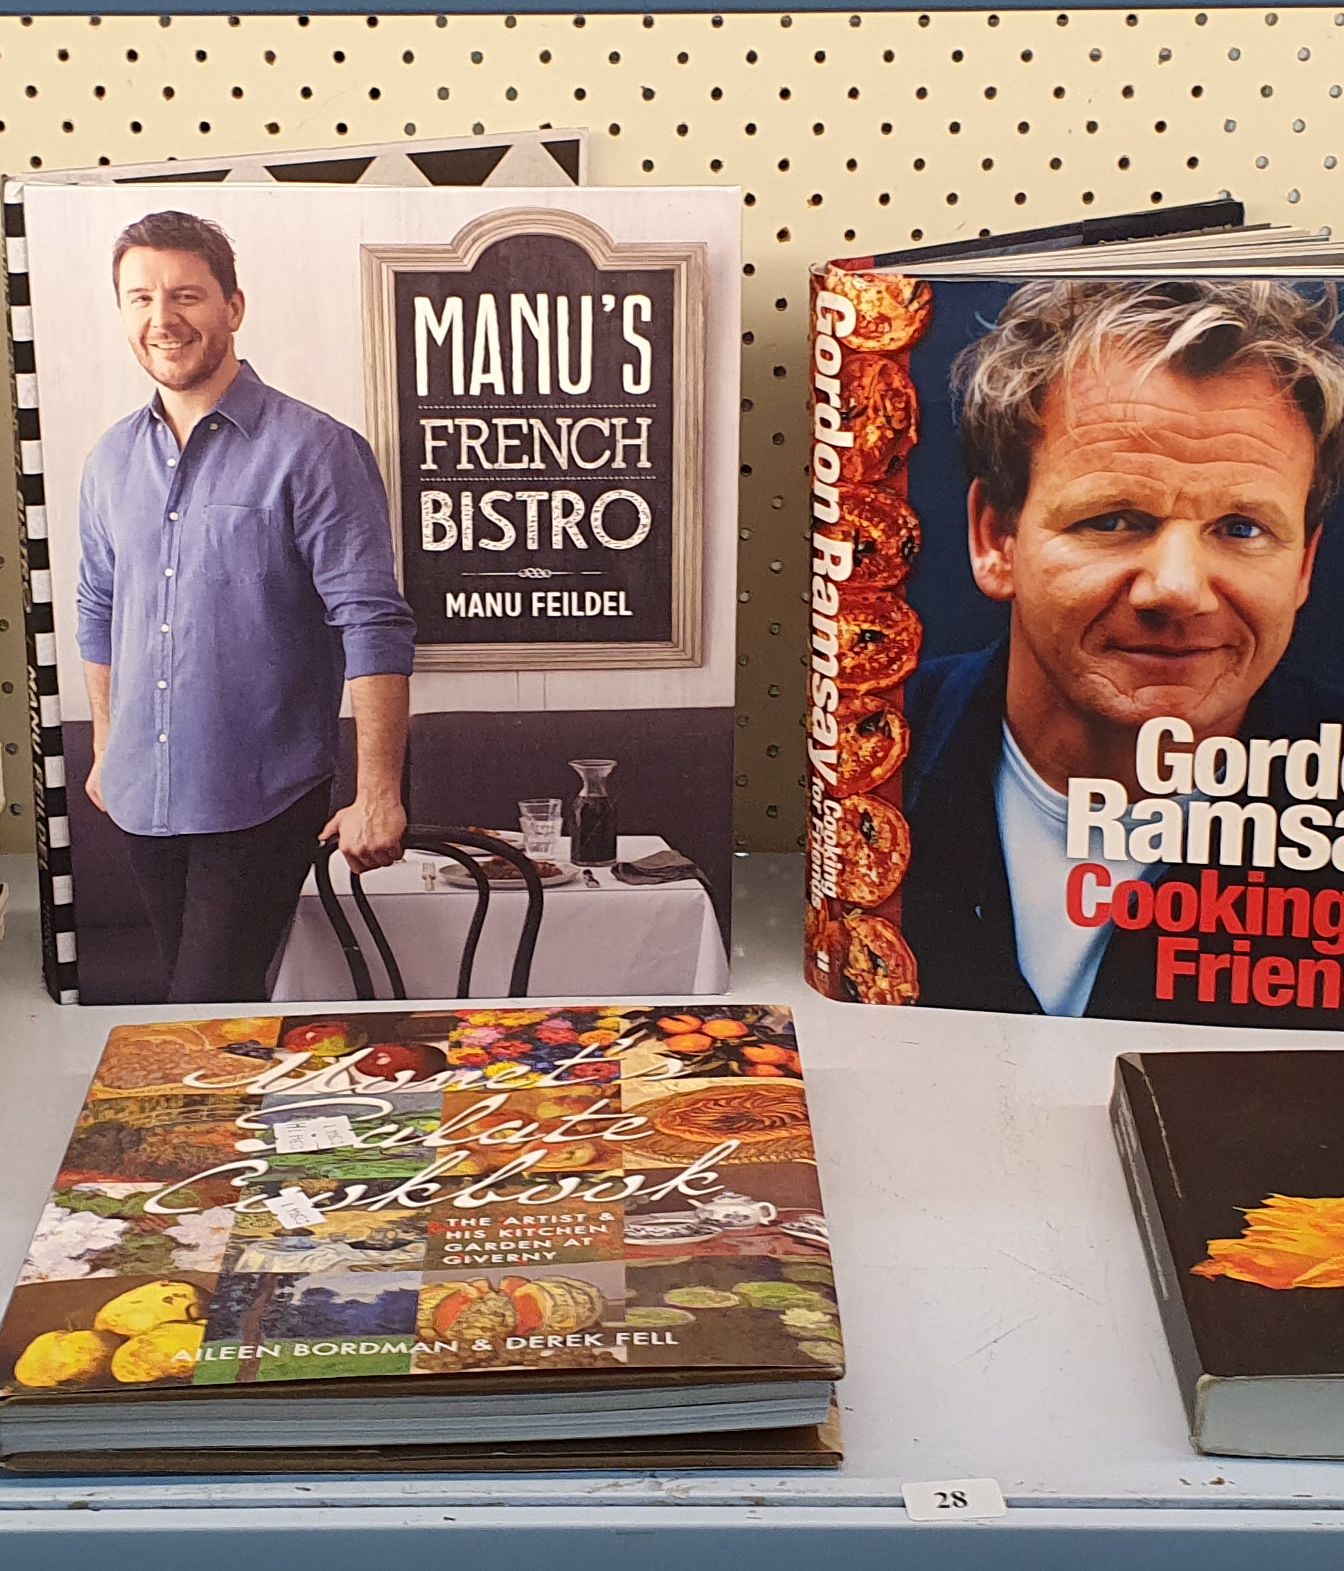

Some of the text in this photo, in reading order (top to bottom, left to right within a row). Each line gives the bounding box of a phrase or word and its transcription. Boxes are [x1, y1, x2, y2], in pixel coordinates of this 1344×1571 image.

[414, 293, 652, 396] MANU'S
[420, 417, 652, 470] FRENCH
[420, 489, 652, 551] BISTRO
[806, 291, 856, 787] Gordon Ramsay
[446, 591, 633, 618] MANU FEILDEL
[810, 775, 825, 910] for Friends
[823, 799, 843, 899] Cooking
[183, 1025, 688, 1095] Monet's
[234, 1094, 654, 1153] Palate
[145, 1140, 741, 1214] Cookbook
[444, 1237, 594, 1252] GARDEN AT
[446, 1212, 616, 1227] THE ARTIST &
[446, 1225, 607, 1240] HIS KITCHEN
[442, 1251, 557, 1265] GIVERNY
[170, 1331, 680, 1364] AILEEN BORDMAN & DEREK FELL
[934, 1490, 968, 1509] 28
